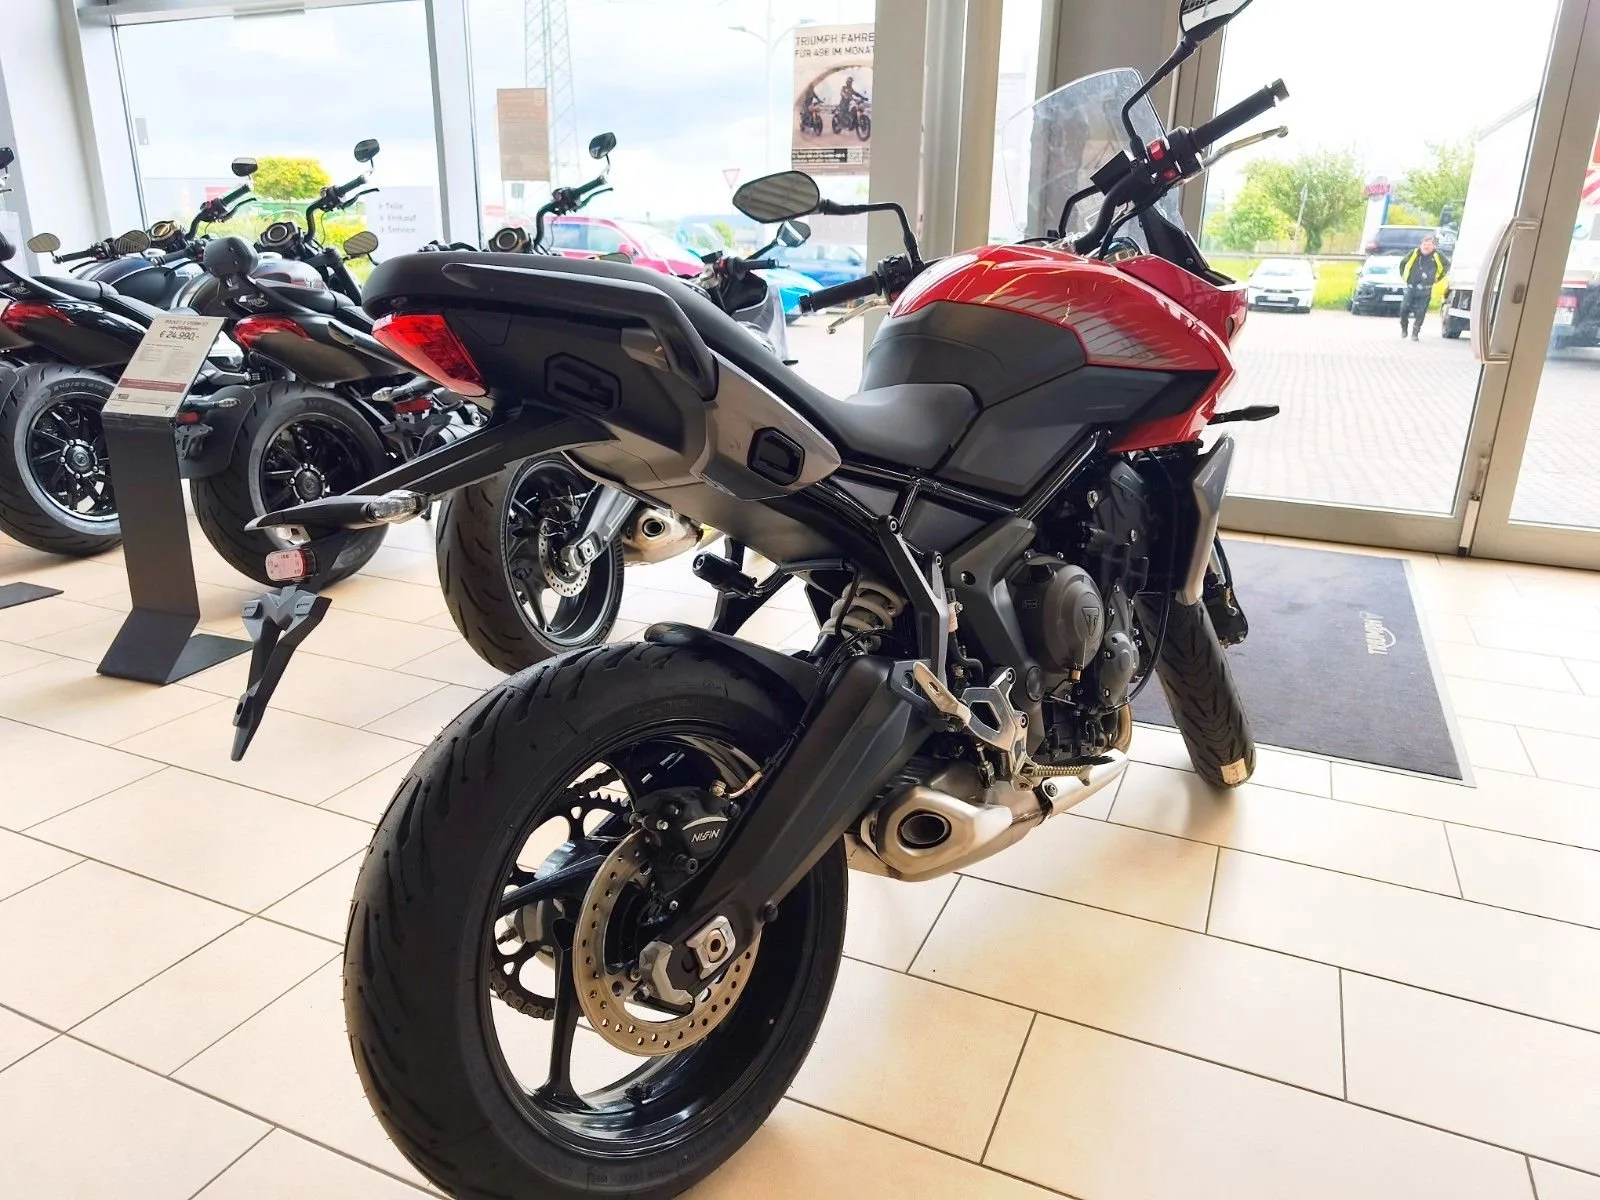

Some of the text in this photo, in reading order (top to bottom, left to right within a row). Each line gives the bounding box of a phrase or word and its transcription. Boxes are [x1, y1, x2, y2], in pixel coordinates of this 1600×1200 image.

[795, 33, 838, 46] TRIUMPH
[794, 48, 811, 58] FÜR
[832, 46, 842, 56] IM
[159, 330, 166, 338] €
